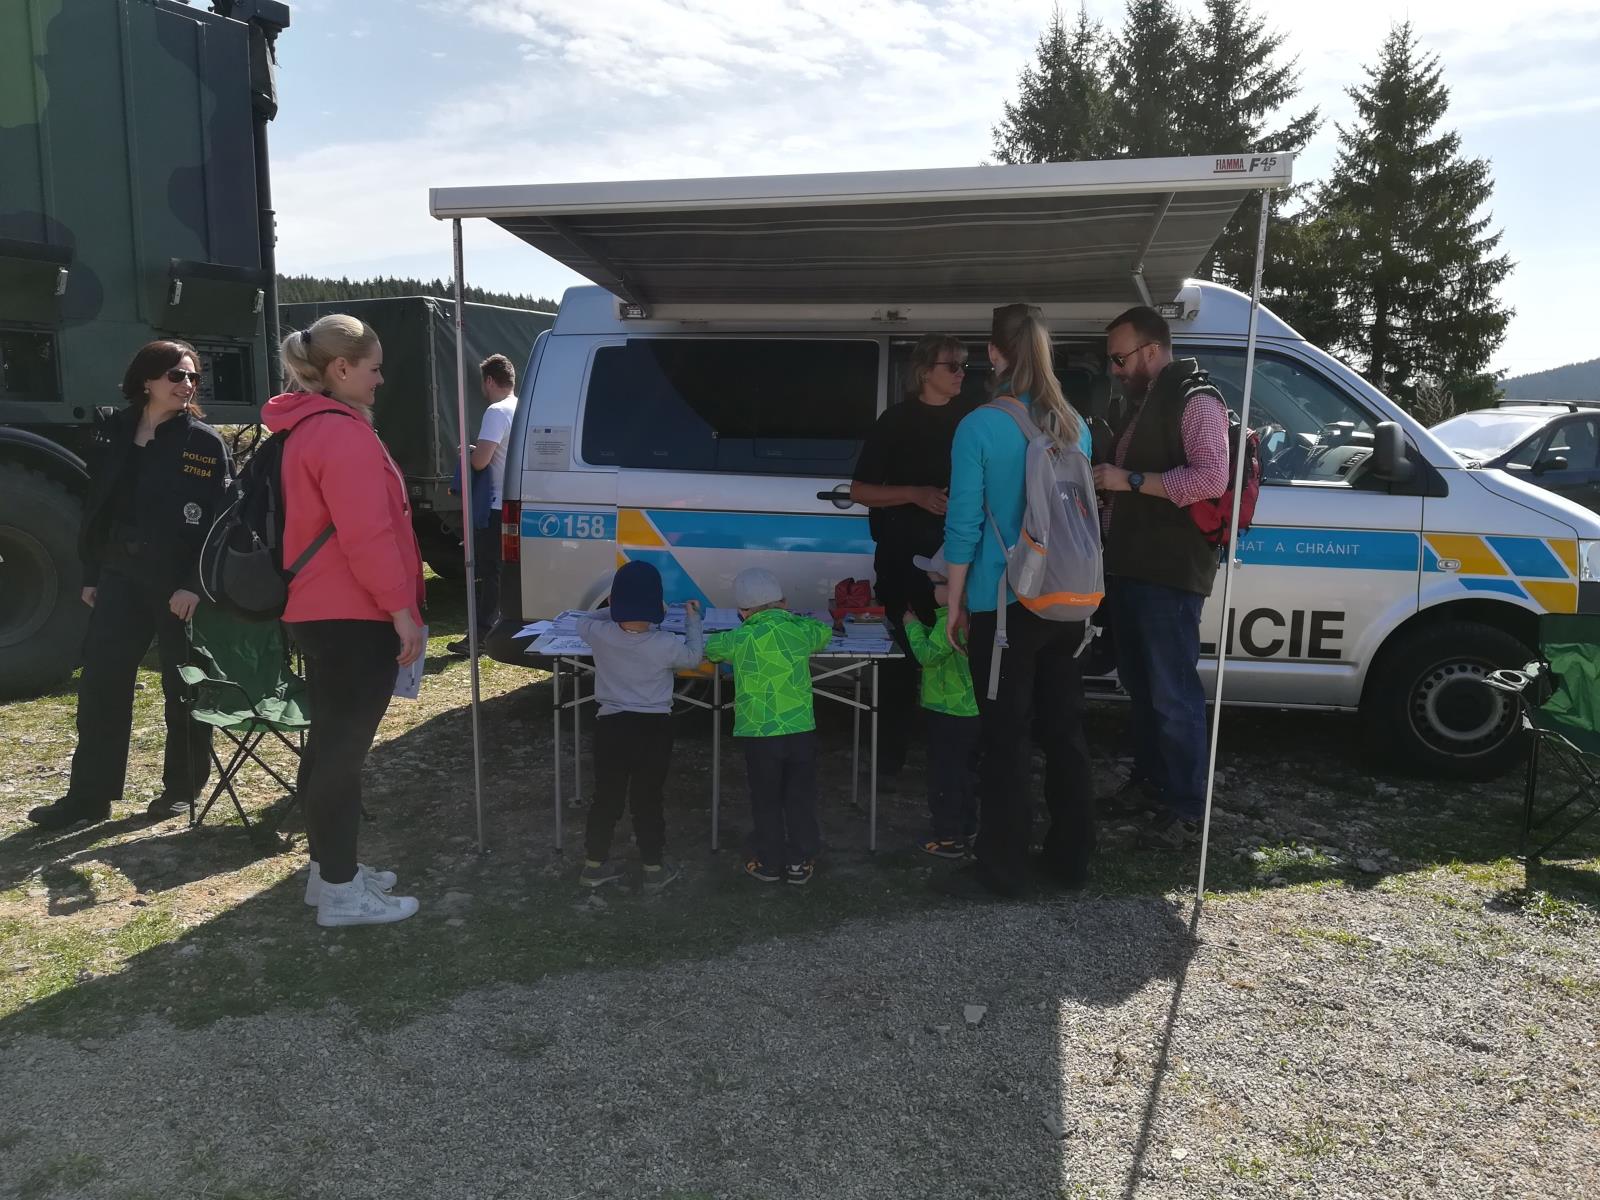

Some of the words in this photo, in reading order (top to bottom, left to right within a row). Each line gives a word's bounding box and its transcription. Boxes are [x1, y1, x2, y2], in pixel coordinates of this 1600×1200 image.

[1216, 159, 1244, 170] FIAMMA
[183, 451, 217, 464] POLICIE
[564, 515, 604, 538] 158
[1275, 542, 1285, 552] A
[1296, 541, 1360, 555] CHRÁNIT
[1200, 608, 1345, 659] ICIE
